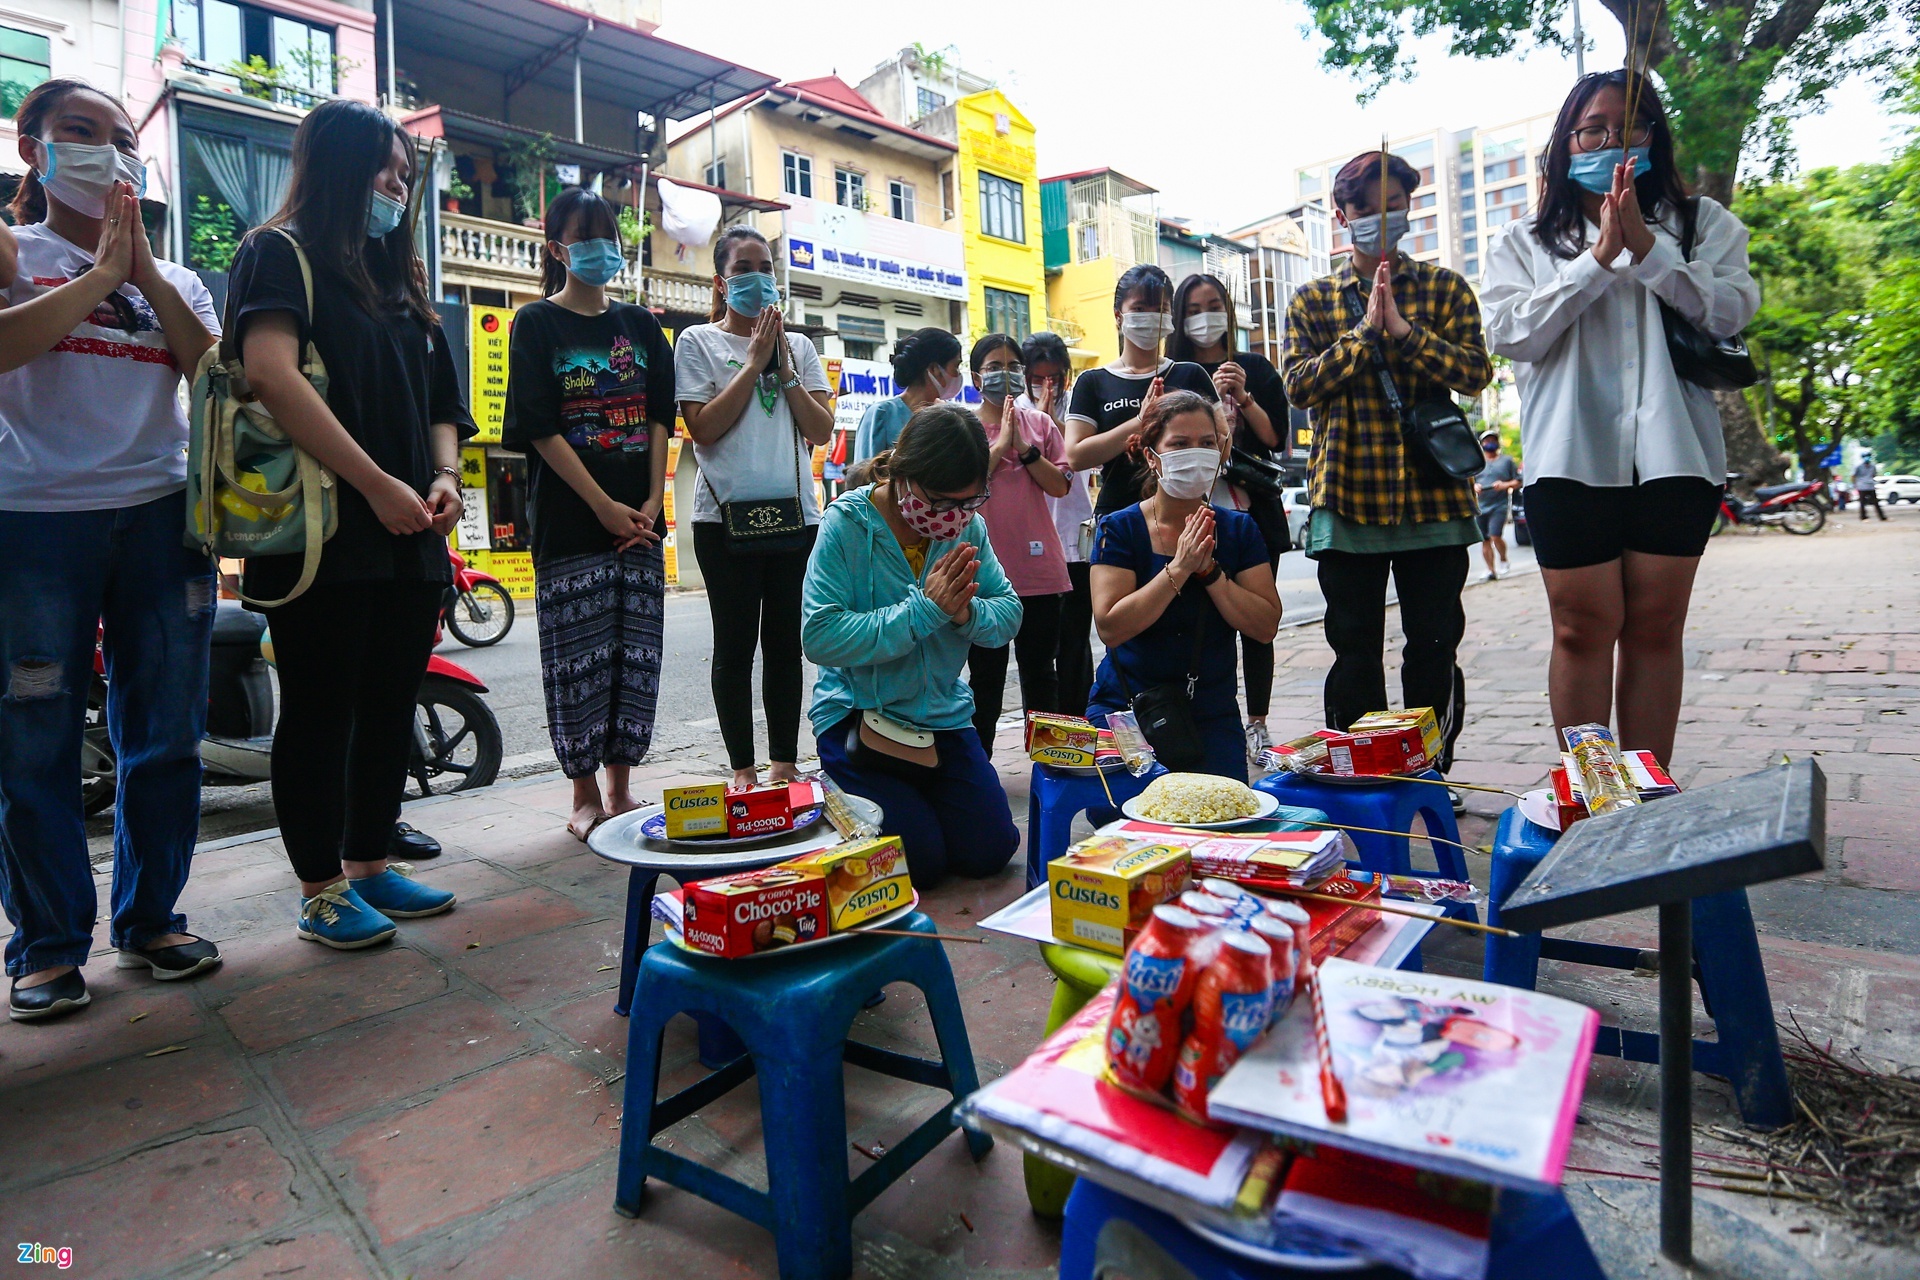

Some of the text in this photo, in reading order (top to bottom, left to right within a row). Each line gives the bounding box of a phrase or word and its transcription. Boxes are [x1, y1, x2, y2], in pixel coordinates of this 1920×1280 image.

[564, 367, 595, 391] Shakes
[1104, 398, 1140, 412] adid
[1043, 748, 1083, 764] Custas
[669, 796, 719, 810] Custas
[767, 889, 794, 900] ORION
[848, 882, 900, 912] Custas
[1055, 880, 1120, 910] Custas
